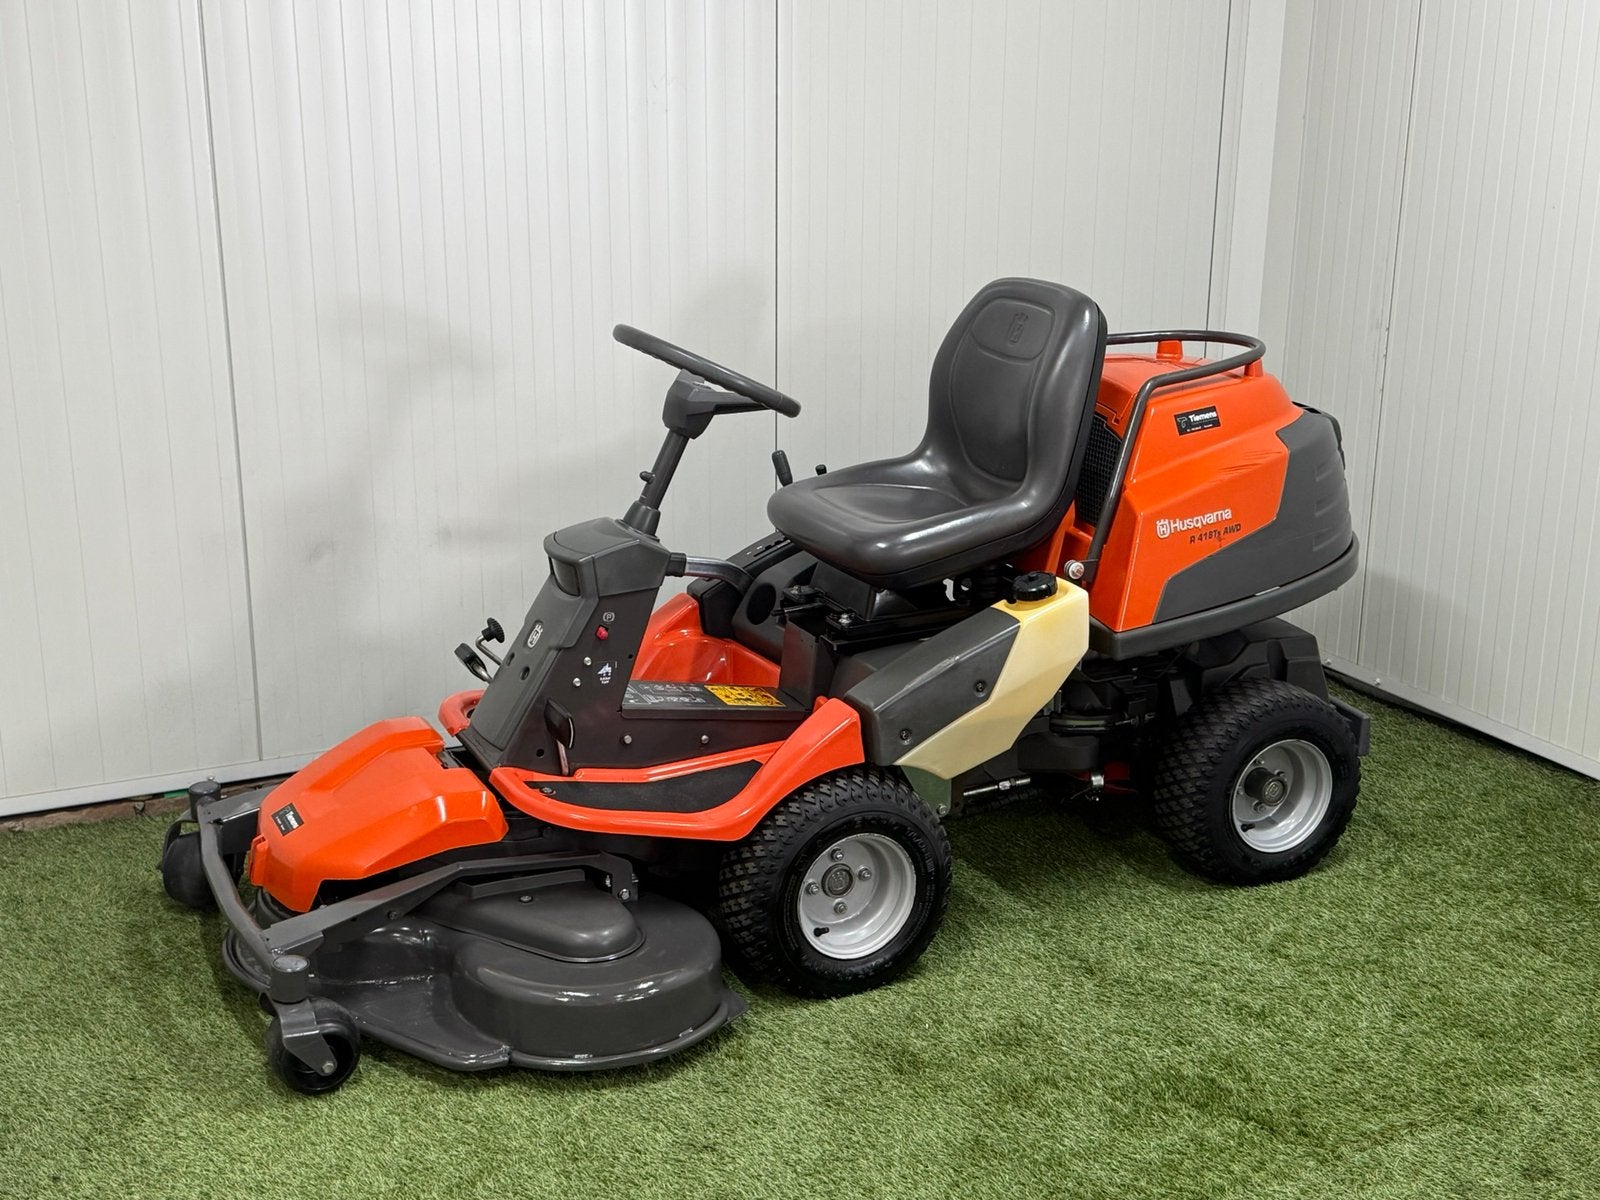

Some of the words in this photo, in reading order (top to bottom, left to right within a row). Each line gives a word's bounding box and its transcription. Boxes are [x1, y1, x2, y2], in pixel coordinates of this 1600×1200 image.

[1170, 508, 1232, 533] Husqvarna
[1189, 535, 1196, 544] R
[1223, 523, 1242, 535] AWD
